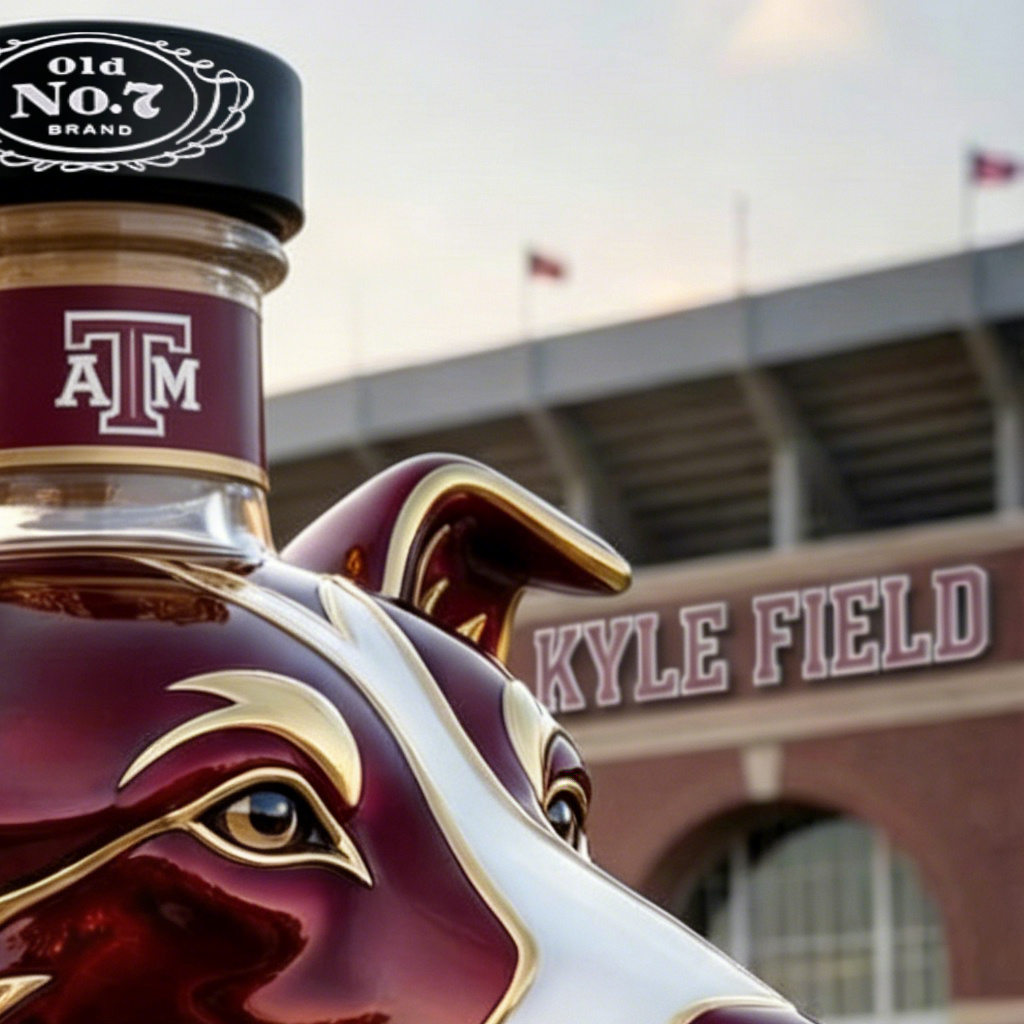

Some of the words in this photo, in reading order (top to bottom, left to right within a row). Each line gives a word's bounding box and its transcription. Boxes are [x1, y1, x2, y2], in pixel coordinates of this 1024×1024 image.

[48, 57, 126, 76] Old
[48, 124, 133, 136] BRAND
[533, 601, 729, 713] KYLE
[752, 564, 990, 686] FIELD
